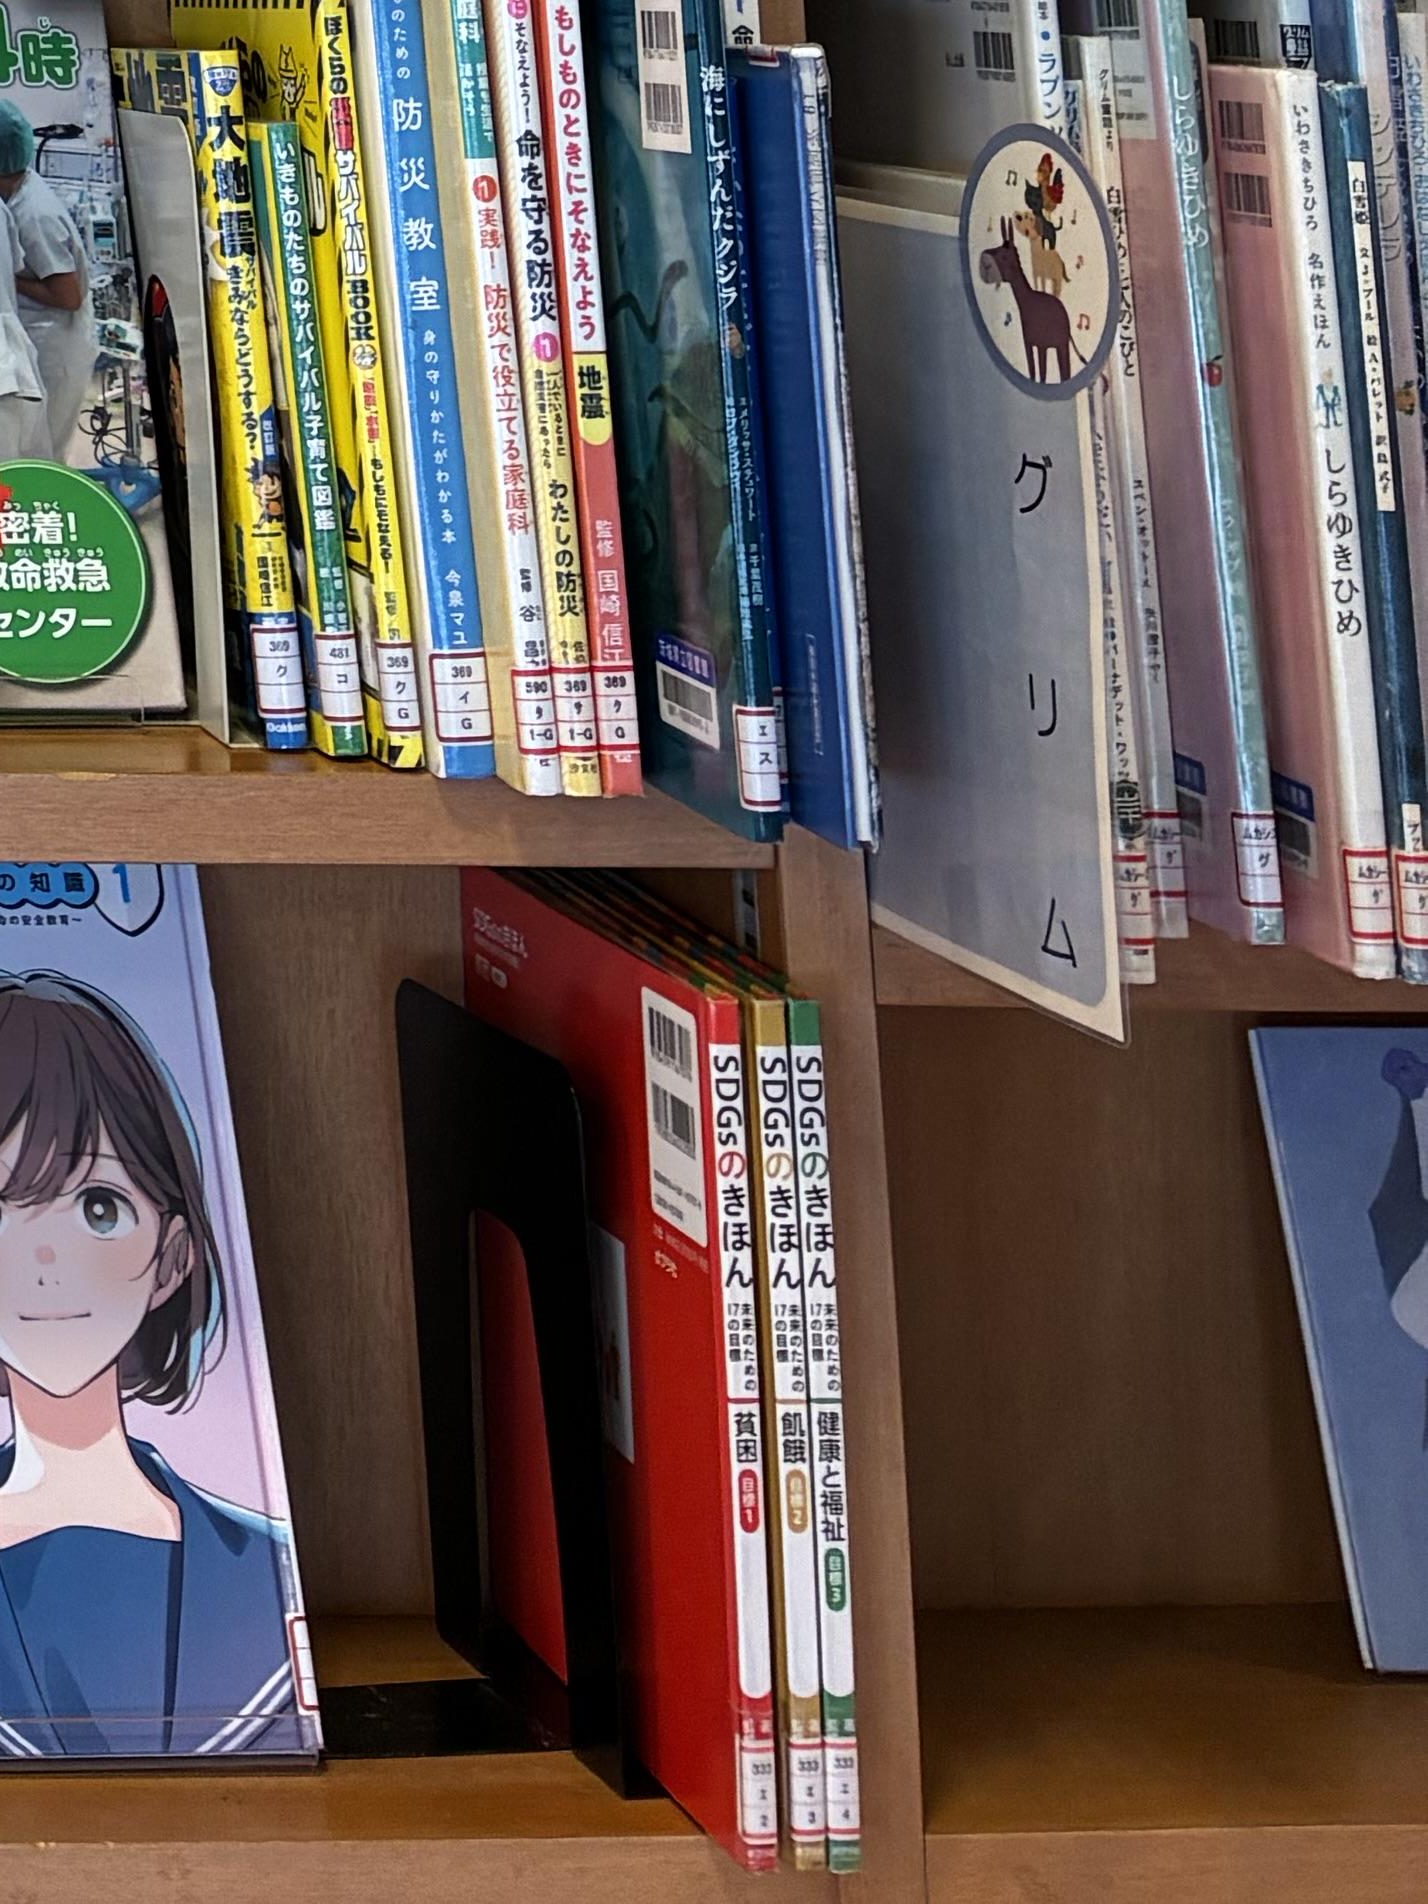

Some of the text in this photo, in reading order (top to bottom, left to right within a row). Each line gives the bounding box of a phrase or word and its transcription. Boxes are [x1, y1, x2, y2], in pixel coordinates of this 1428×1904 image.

[391, 95, 442, 312] 防災教室
[515, 128, 558, 323] 命を守る防災
[554, 4, 598, 341] もしものときにそなえよう
[698, 64, 739, 311] 海にしずんだクジラ
[1292, 103, 1331, 350] いわさきちひろ 名作えほん
[275, 141, 337, 533] いきものたちのサバイバル子育て図鑑
[423, 328, 458, 545] 身の守りかたがわかる本
[482, 283, 531, 536] 防災で役立てる家庭科
[577, 363, 607, 421] 地震
[548, 478, 581, 618] わたしの防災
[1322, 448, 1362, 638] しらゆきひめ
[1013, 449, 1079, 970] グリム
[712, 1055, 754, 1289] SDGsのきほん
[759, 1055, 803, 1290] SDGsのきほん
[795, 1055, 836, 1290] SDGsのきほん
[733, 1412, 759, 1464] 貧困
[781, 1412, 808, 1464] 飢餓
[816, 1410, 846, 1543] 健康と福祉
